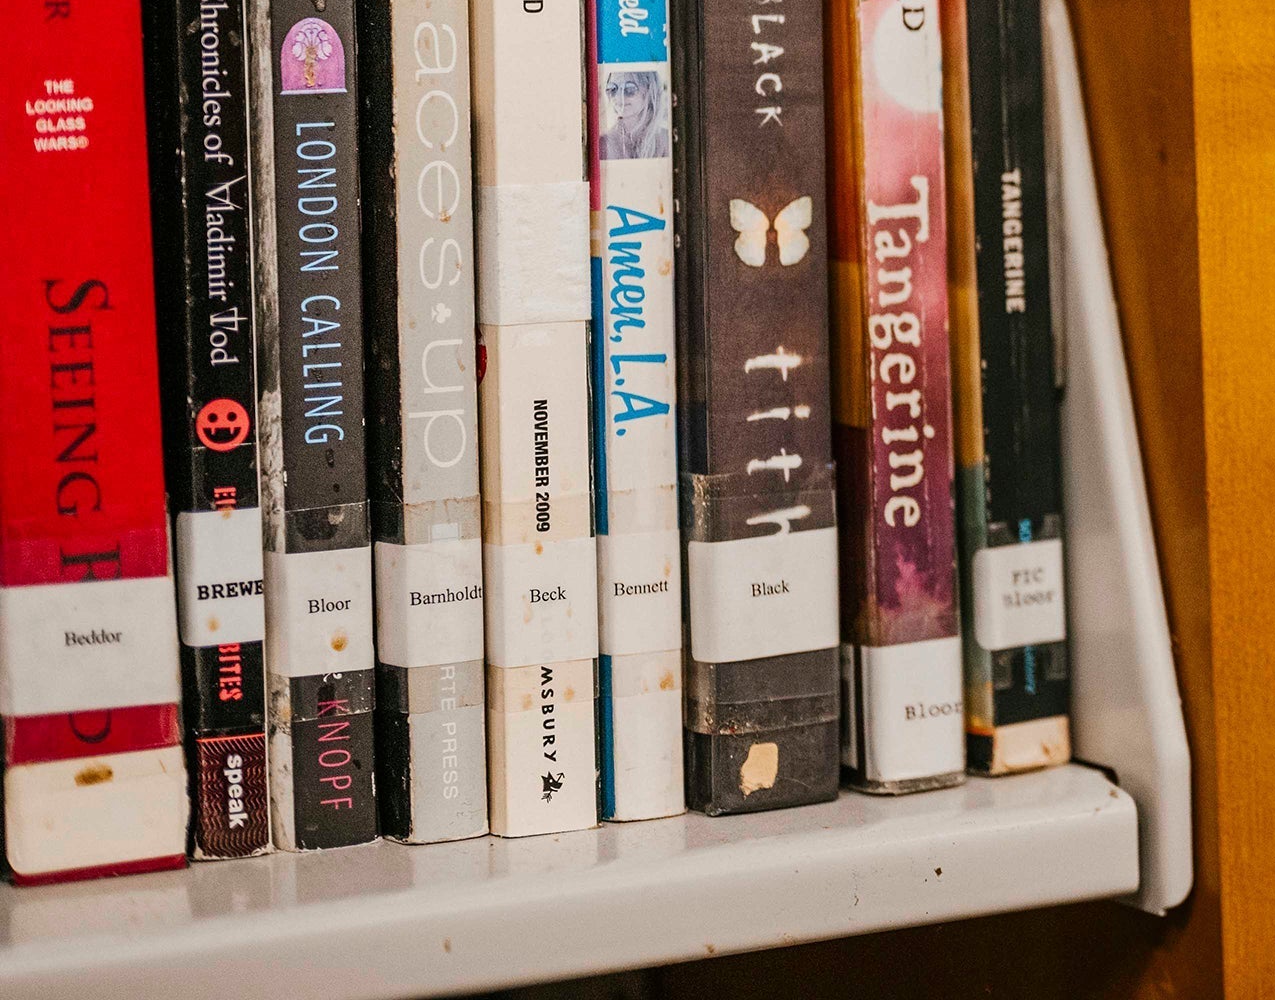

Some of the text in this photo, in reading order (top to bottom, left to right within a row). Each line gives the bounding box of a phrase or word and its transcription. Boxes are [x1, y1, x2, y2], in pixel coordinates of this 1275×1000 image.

[25, 97, 94, 116] LOOKING
[44, 79, 75, 94] THE
[35, 116, 86, 134] GLASS
[203, 133, 234, 167] of
[205, 174, 247, 302] Vladimir
[408, 21, 467, 468] aces up
[296, 121, 345, 445] LONDON CALLING
[605, 204, 671, 437] Amen, L.A.
[866, 174, 936, 529] Tangerine
[44, 278, 115, 517] SEEING
[533, 399, 551, 533] NOVEMBER 2009
[308, 597, 351, 614] Bloor
[410, 585, 483, 607] Barnholdt
[529, 586, 567, 604] Beck
[613, 579, 669, 597] Bennett
[751, 580, 790, 597] Black
[64, 630, 122, 648] Beddor
[317, 700, 353, 810] KNOPF
[441, 720, 459, 800] PRESS
[223, 752, 249, 830] speak
